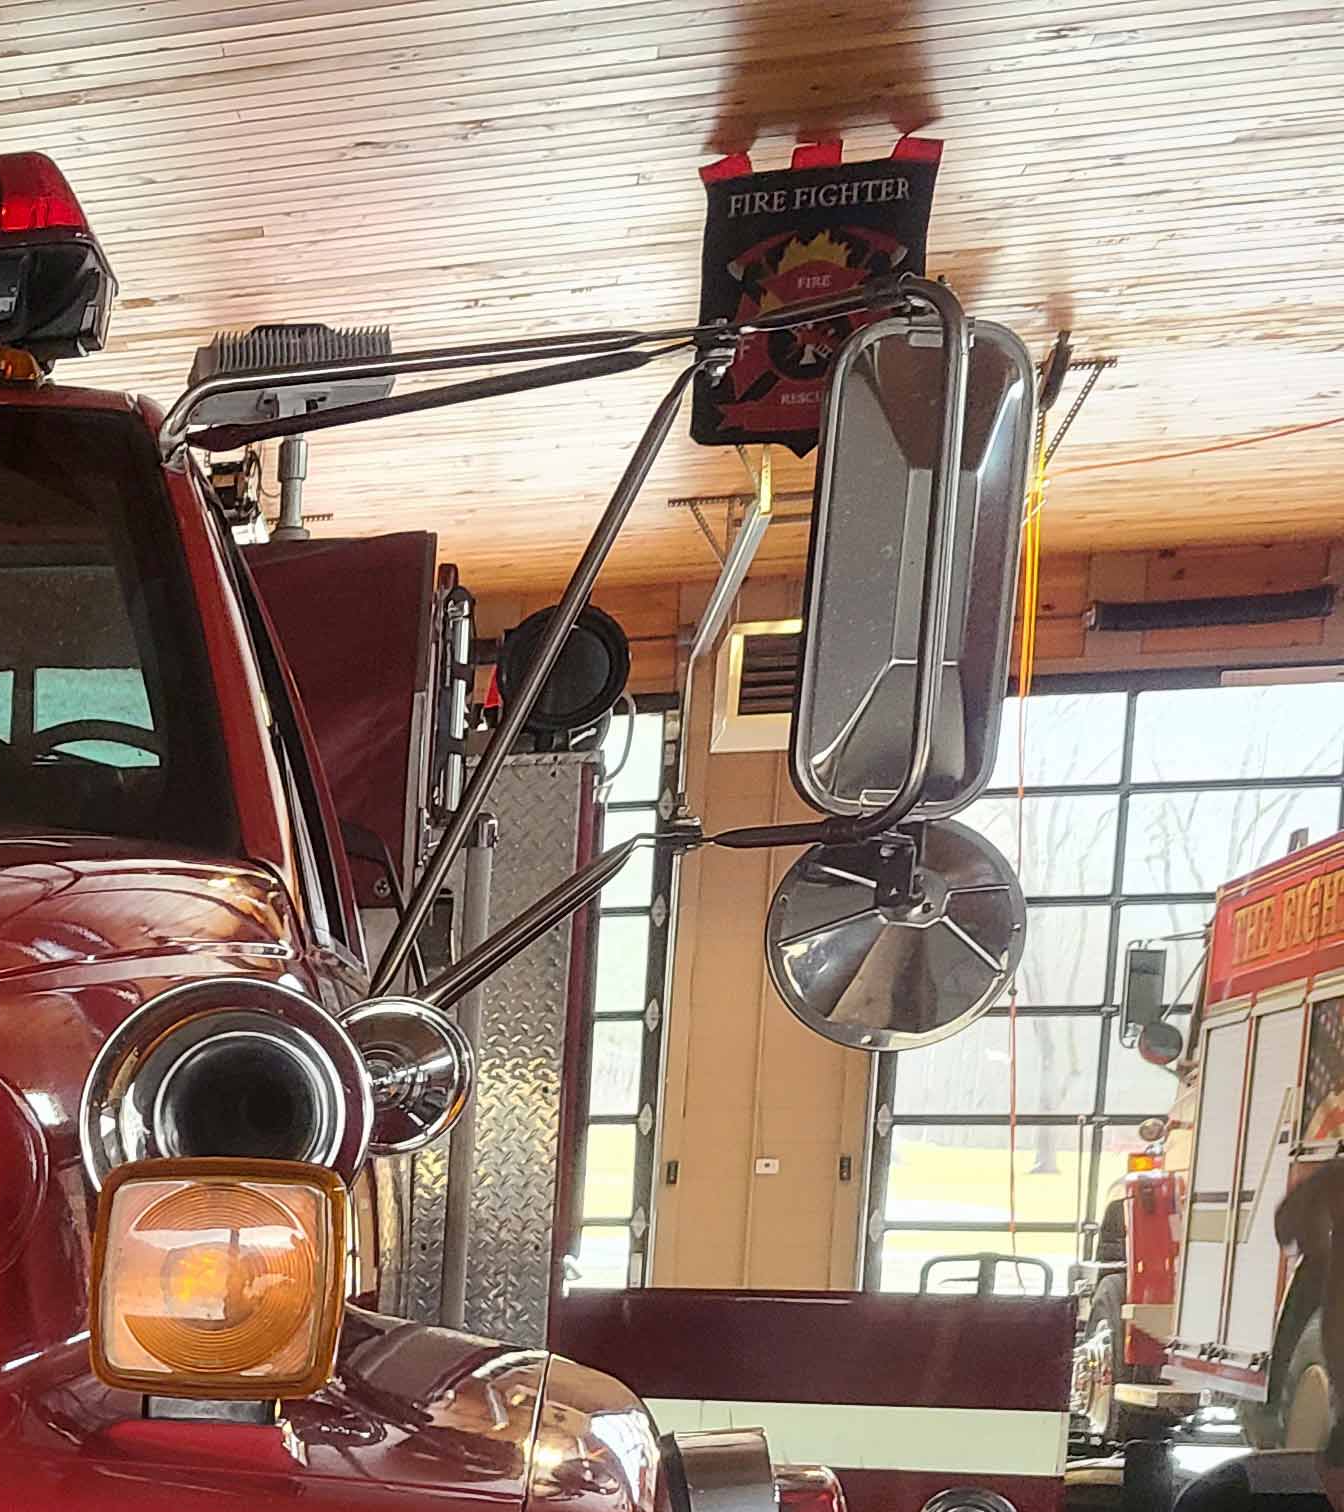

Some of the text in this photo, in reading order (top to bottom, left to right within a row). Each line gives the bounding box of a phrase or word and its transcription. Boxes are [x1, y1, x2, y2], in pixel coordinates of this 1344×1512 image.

[727, 177, 911, 219] FIRE FIGHTER
[797, 274, 832, 289] FIRE
